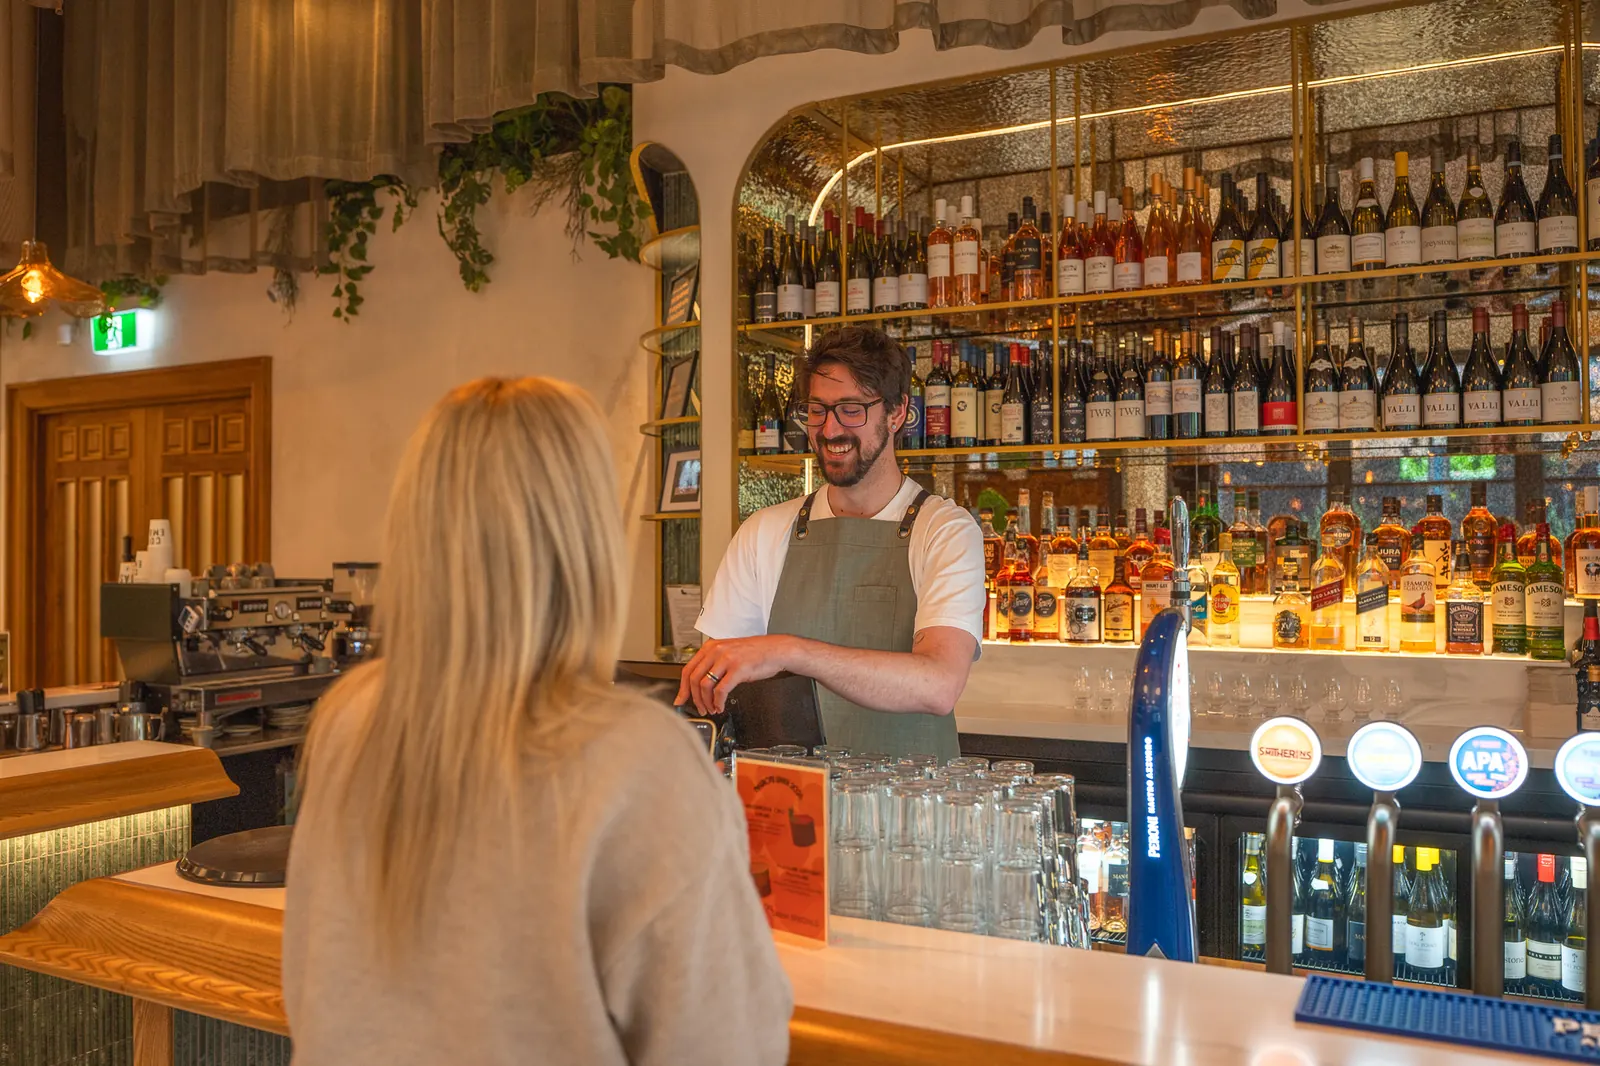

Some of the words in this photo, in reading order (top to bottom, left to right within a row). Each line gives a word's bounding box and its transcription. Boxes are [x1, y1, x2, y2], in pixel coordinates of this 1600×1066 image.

[1426, 403, 1457, 412] VALLI
[1468, 401, 1498, 410] VALLI
[1508, 399, 1539, 407] VALLI
[1090, 408, 1112, 418] TWR
[1120, 406, 1141, 417] TWR
[1387, 404, 1416, 413] VALLI
[1323, 588, 1341, 597] LABEL
[1527, 584, 1564, 596] JAMESON
[1372, 593, 1387, 601] LABEL
[1461, 750, 1505, 772] APA
[1147, 815, 1161, 858] PERONI
